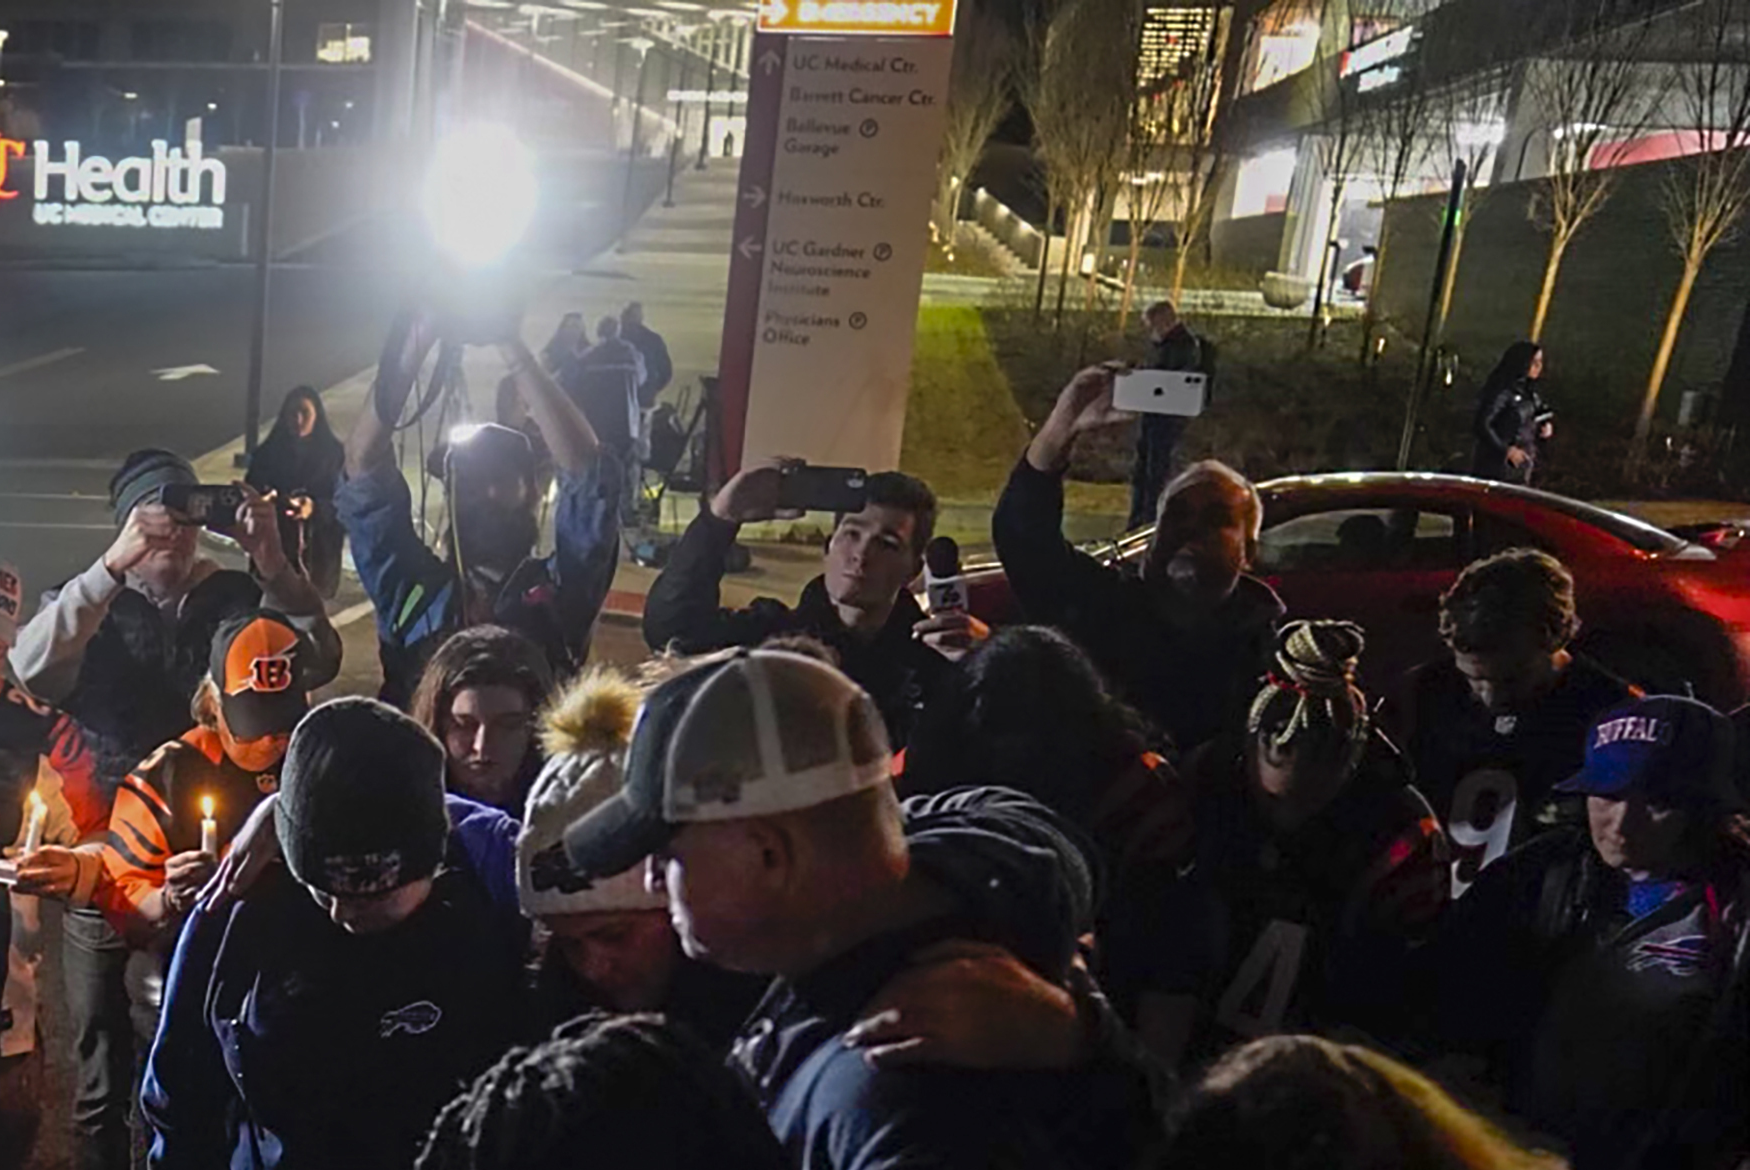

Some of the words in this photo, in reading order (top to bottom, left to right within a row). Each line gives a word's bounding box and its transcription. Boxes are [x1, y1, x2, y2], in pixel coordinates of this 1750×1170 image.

[793, 55, 820, 71] UC
[824, 56, 886, 72] Medical
[890, 57, 918, 74] Ctr.
[849, 88, 904, 104] Cancer
[786, 118, 850, 135] Bellevue
[784, 138, 840, 157] Garage
[33, 139, 226, 205] Health
[772, 240, 799, 256] UC
[802, 242, 865, 259] Gardner
[769, 261, 871, 279] Neuroscience
[767, 279, 830, 297] Institute
[764, 311, 840, 328] Physicians
[762, 328, 810, 346] Office
[1448, 768, 1519, 901] 9
